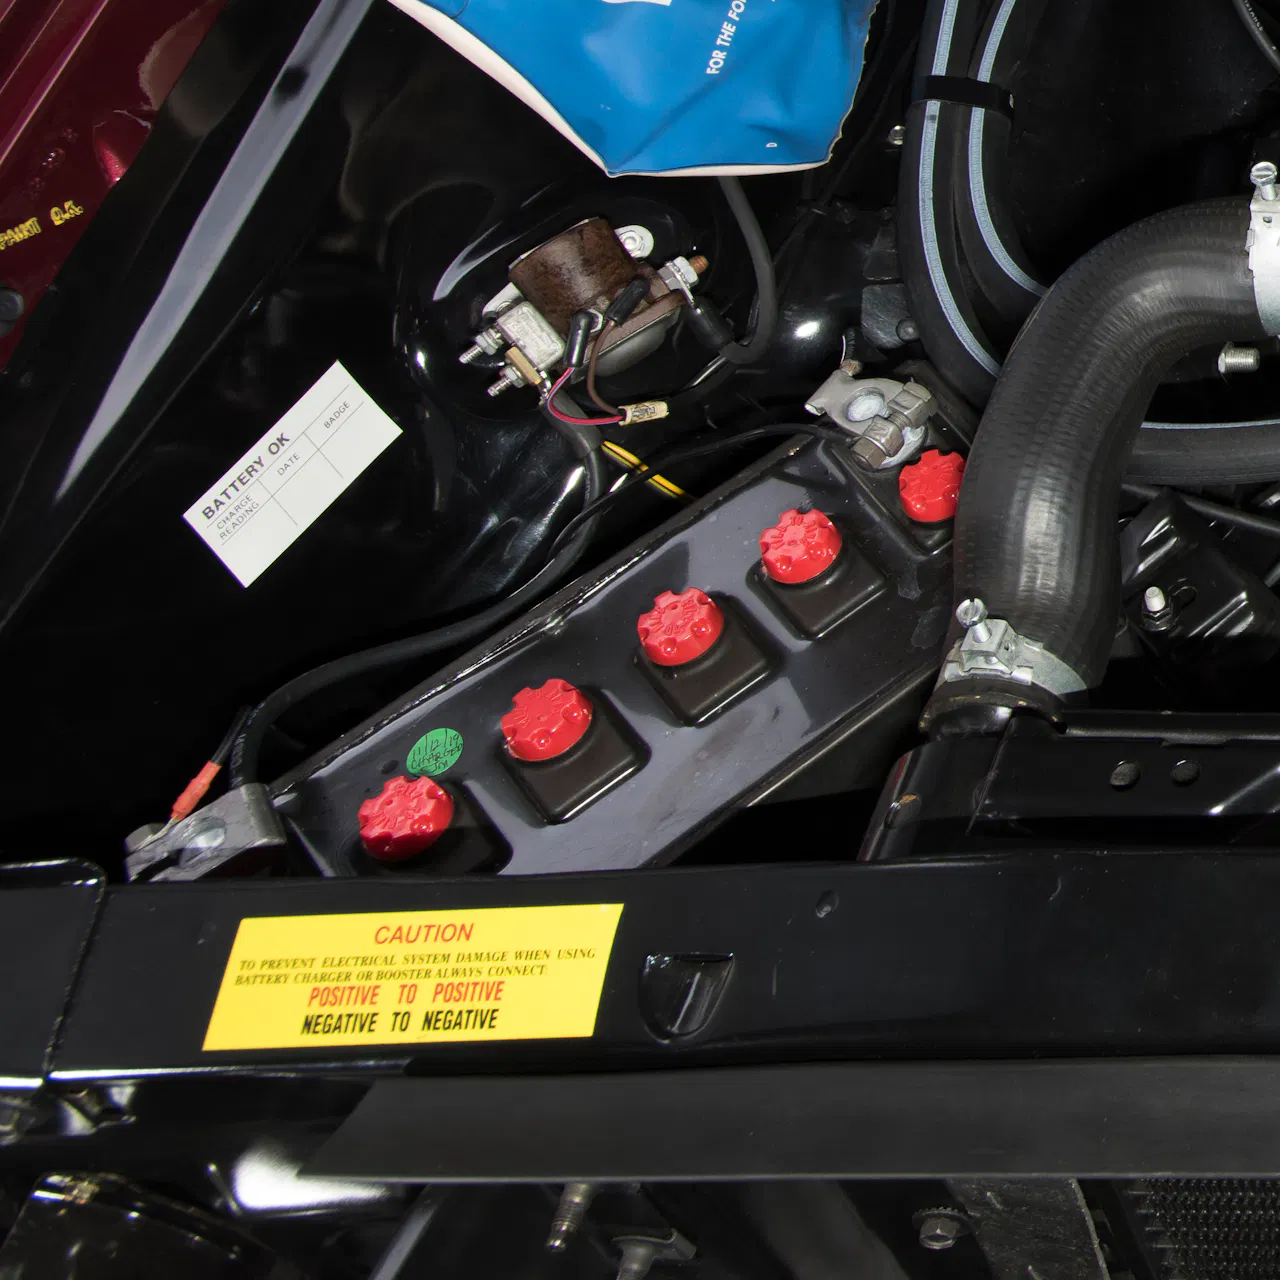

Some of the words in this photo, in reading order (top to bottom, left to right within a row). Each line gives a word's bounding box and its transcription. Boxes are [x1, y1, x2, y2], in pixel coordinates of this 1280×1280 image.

[706, 49, 727, 75] FOR
[717, 21, 736, 47] THE
[323, 401, 351, 429] BADGE
[201, 456, 265, 520] BATTERY
[267, 432, 291, 456] OK
[276, 452, 300, 476] DATE
[216, 494, 254, 531] CHARGE
[219, 501, 260, 540] READING
[411, 743, 463, 770] CHARGED
[413, 728, 460, 759] 11/12/19
[374, 923, 475, 945] CAUTION
[240, 959, 256, 971] TO
[259, 957, 315, 970] PREVENT
[321, 955, 397, 968] ELECTRICAL
[402, 953, 450, 965] SYSTEM
[455, 951, 508, 963] DAMAGE
[513, 950, 551, 961] WHEN
[556, 947, 597, 960] USING
[235, 972, 290, 986] BATTERY
[293, 970, 352, 985] CHARGER
[356, 970, 373, 981] OR
[375, 968, 432, 981] BOOSTER
[435, 966, 482, 979] ALWAYS
[307, 984, 381, 1007] POSITIVE
[397, 983, 417, 1005] TO
[432, 980, 505, 1003] POSITIVE
[300, 1012, 377, 1035] NEGATIVE
[390, 1011, 410, 1033] TO
[421, 1008, 500, 1032] NEGATIVE
